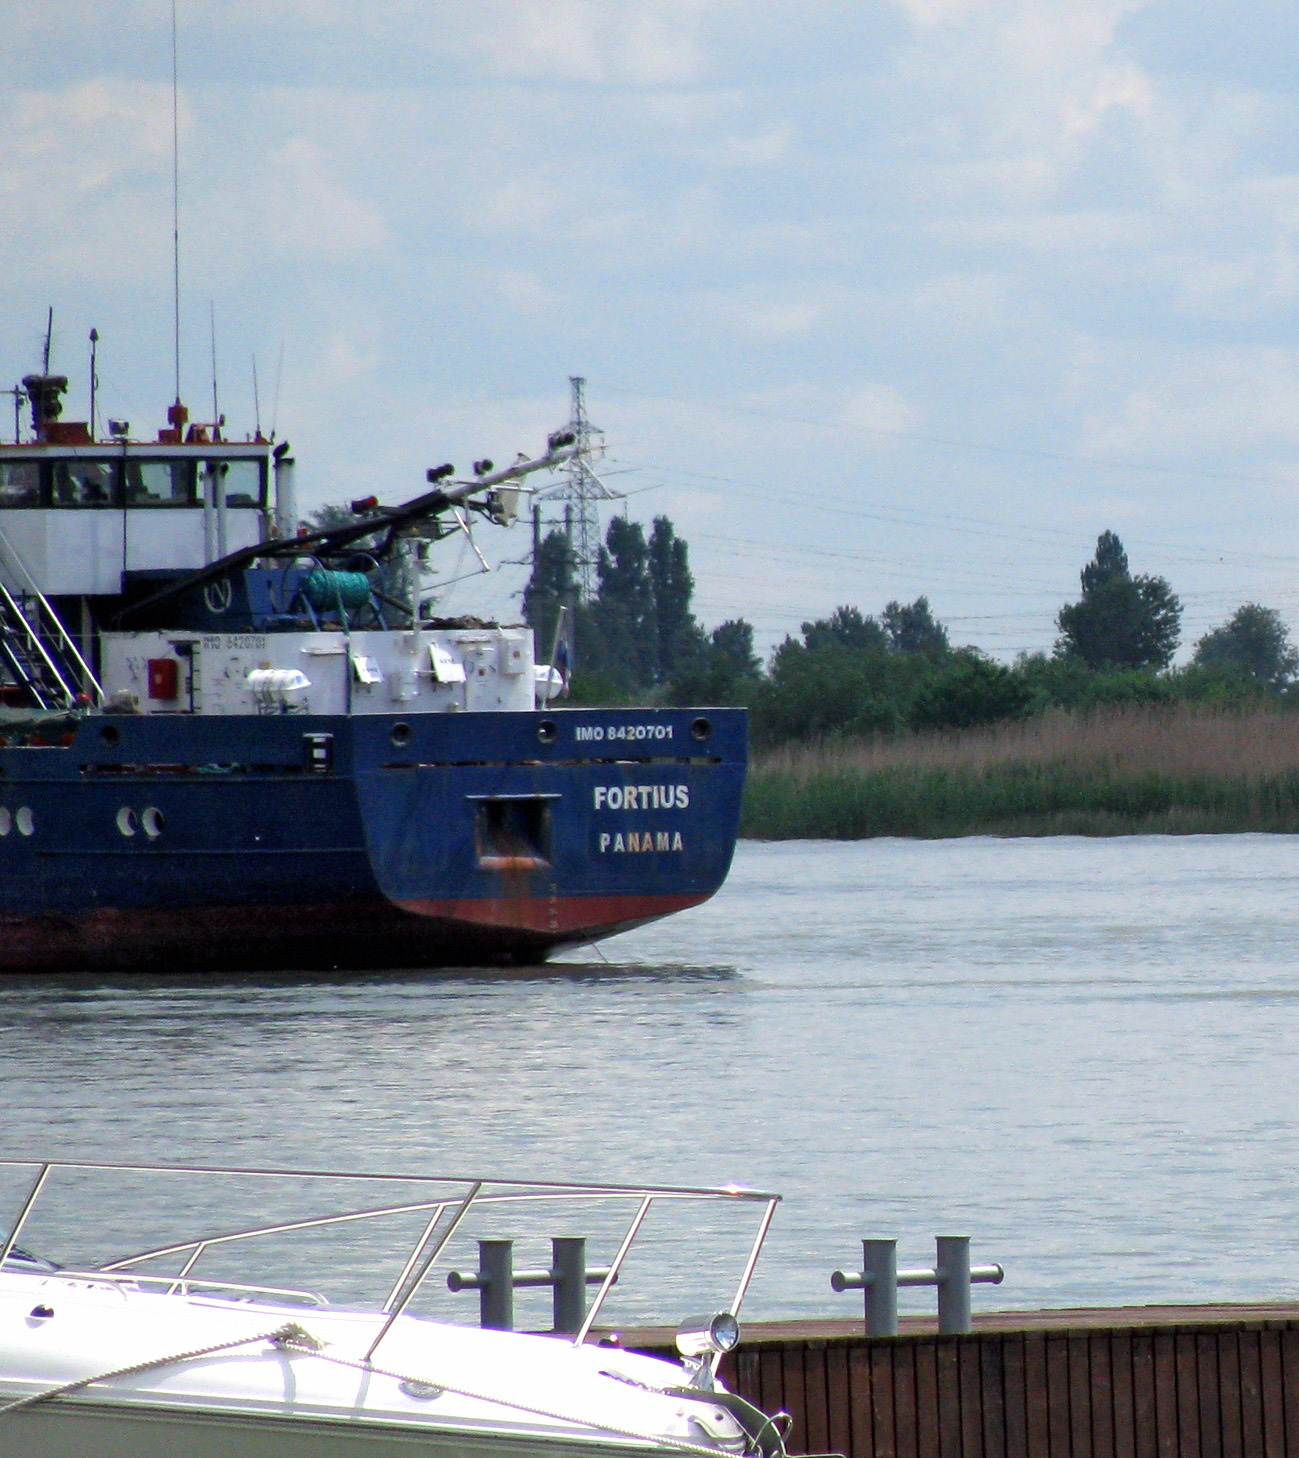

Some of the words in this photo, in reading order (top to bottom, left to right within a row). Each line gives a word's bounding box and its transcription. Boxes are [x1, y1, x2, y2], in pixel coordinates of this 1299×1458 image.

[575, 726, 604, 741] IMO
[607, 725, 673, 741] 8420701
[594, 785, 690, 810] FORTIUS
[600, 831, 684, 853] PANAMA
